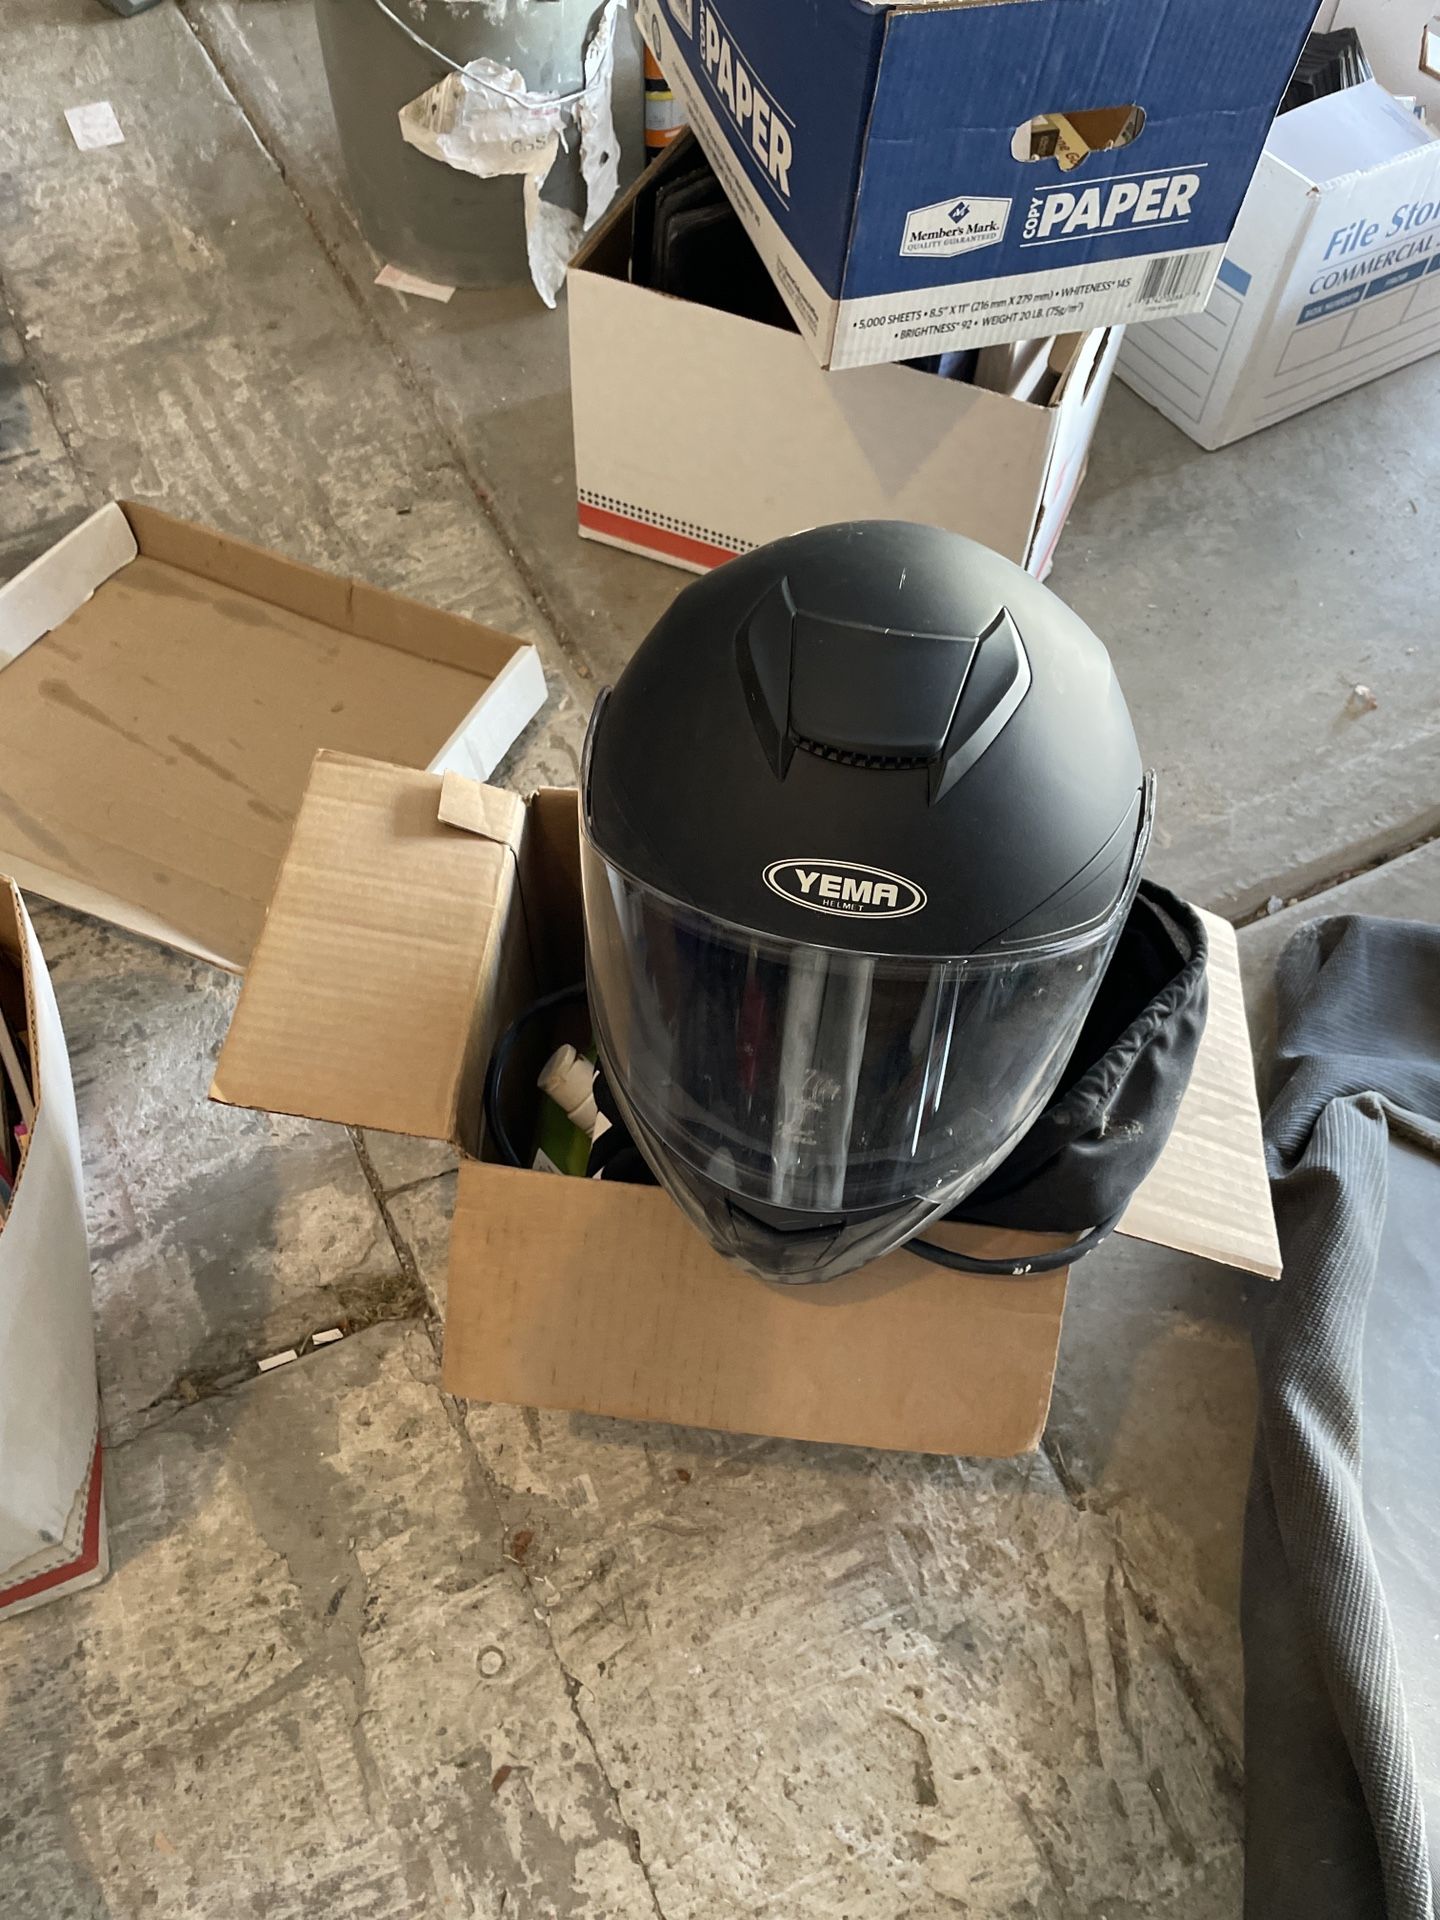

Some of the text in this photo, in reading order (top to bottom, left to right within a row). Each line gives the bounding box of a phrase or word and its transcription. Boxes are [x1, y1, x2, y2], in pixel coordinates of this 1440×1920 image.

[706, 6, 793, 198] PAPER
[1022, 197, 1044, 239] COPY
[1037, 174, 1200, 238] PAPER
[906, 231, 997, 252] QUALITY GUARANTEED
[909, 226, 964, 243] Member's
[1323, 219, 1379, 262] File
[1309, 234, 1433, 295] COMMERCIAL
[858, 315, 886, 330] 5,000
[887, 310, 922, 325] SHEETS
[949, 306, 956, 315] X
[970, 300, 990, 313] (216
[990, 300, 1007, 309] mm
[1008, 296, 1015, 306] X
[1016, 294, 1033, 305] 279
[1033, 290, 1054, 302] mm)
[1116, 277, 1132, 289] 145
[961, 319, 973, 330] 92
[982, 312, 1018, 326] WEIGHT
[1019, 310, 1031, 321] 20
[795, 868, 899, 908] YEMA
[822, 899, 865, 912] HELMET
